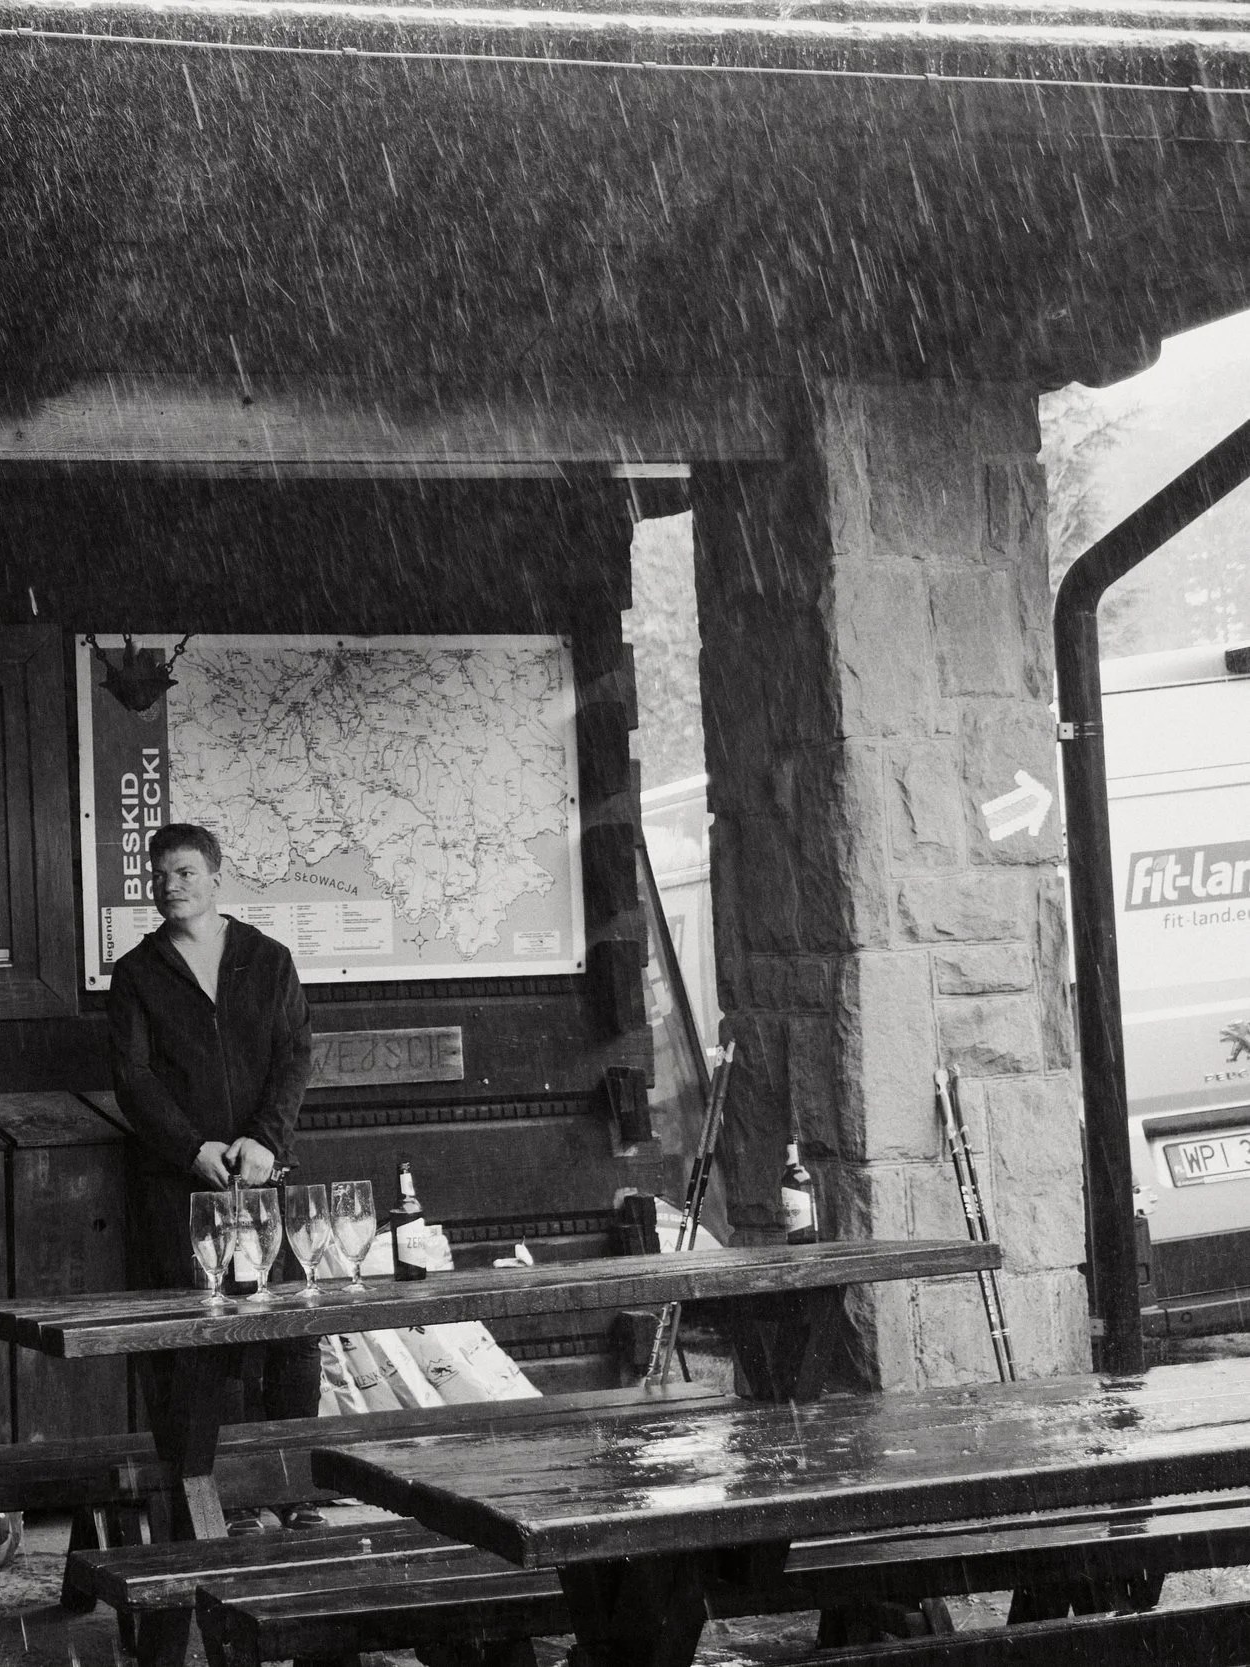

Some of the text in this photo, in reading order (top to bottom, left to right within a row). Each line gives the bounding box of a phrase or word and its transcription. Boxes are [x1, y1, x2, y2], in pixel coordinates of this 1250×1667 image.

[121, 772, 142, 900] BESKID
[294, 871, 358, 896] SŁOWACJA
[1164, 907, 1250, 929] fit-land.e
[105, 907, 113, 962] legenda
[406, 1236, 426, 1250] ZER
